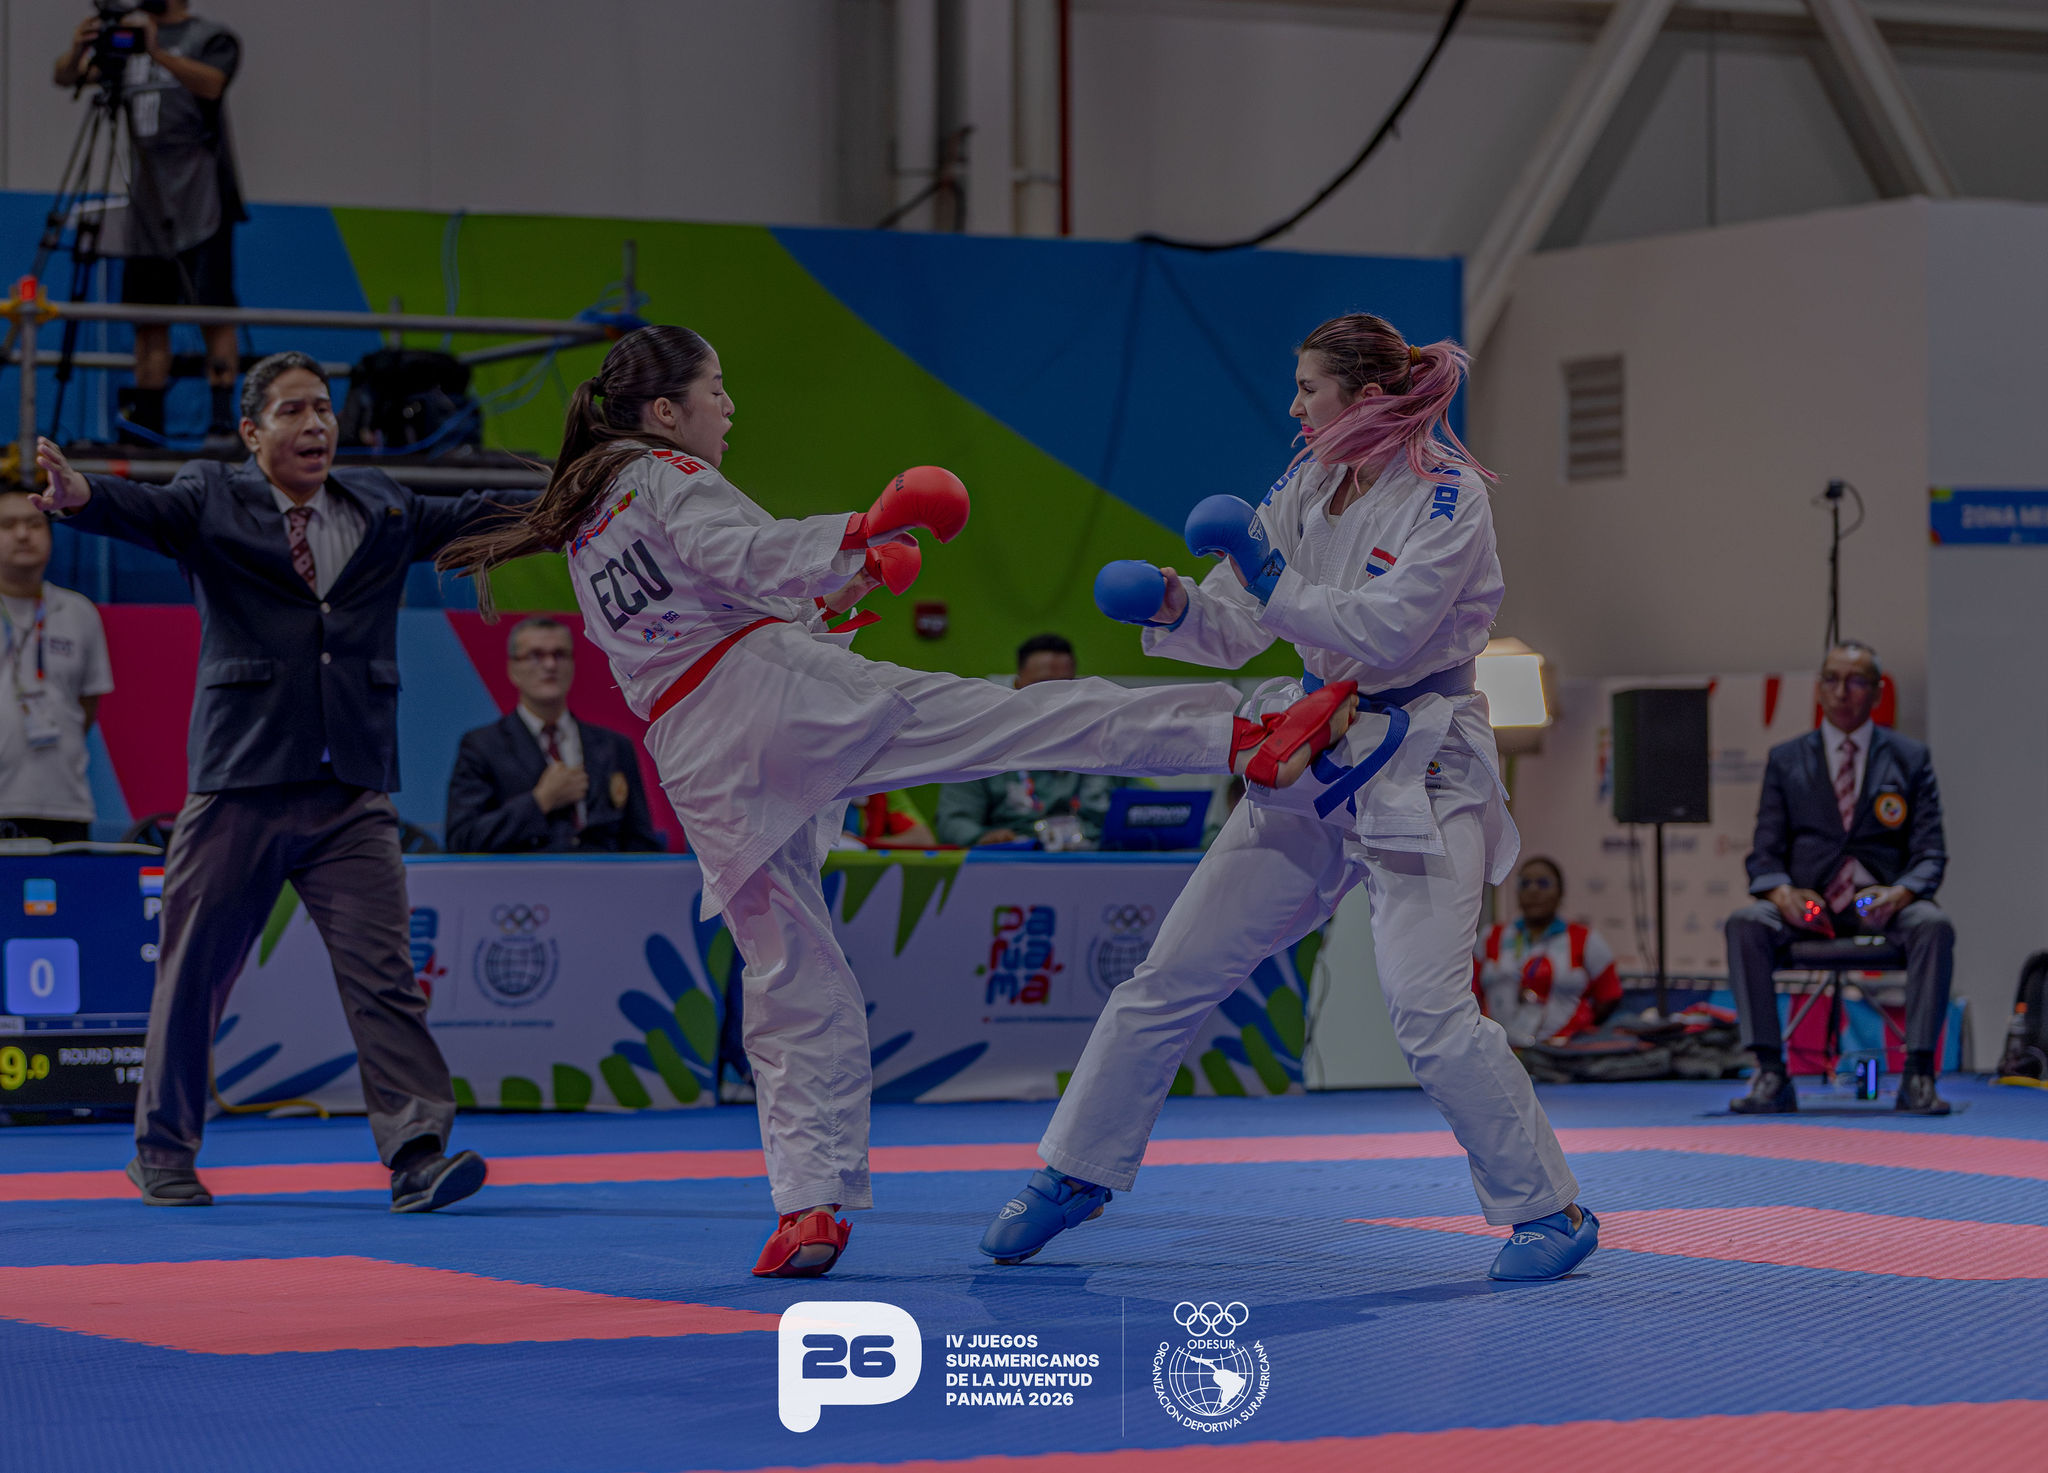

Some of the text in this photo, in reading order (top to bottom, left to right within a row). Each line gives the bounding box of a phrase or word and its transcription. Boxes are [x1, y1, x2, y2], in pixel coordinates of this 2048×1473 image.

[590, 539, 673, 632] ECU
[29, 958, 55, 998] 0
[59, 1047, 112, 1066] ROUND
